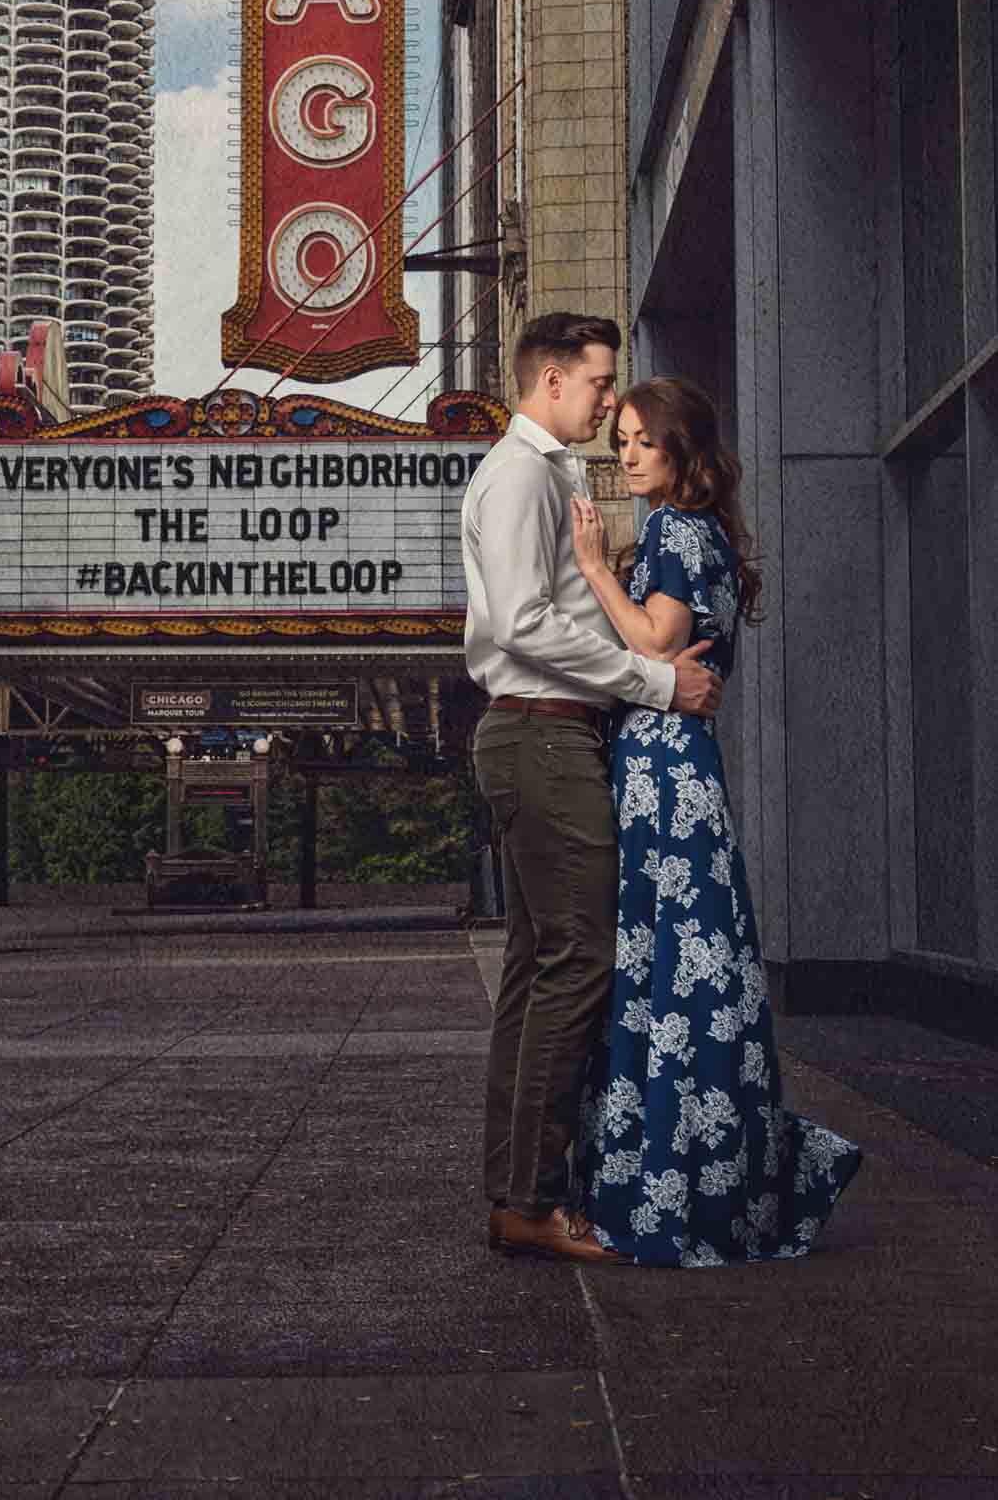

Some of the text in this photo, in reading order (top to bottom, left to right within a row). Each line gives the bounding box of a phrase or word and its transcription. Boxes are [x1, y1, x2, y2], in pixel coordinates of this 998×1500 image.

[134, 507, 340, 544] THE LOOP
[76, 560, 402, 597] #BACKINTHELOOP
[148, 695, 203, 705] CHICAGO
[185, 709, 205, 717] TOUR
